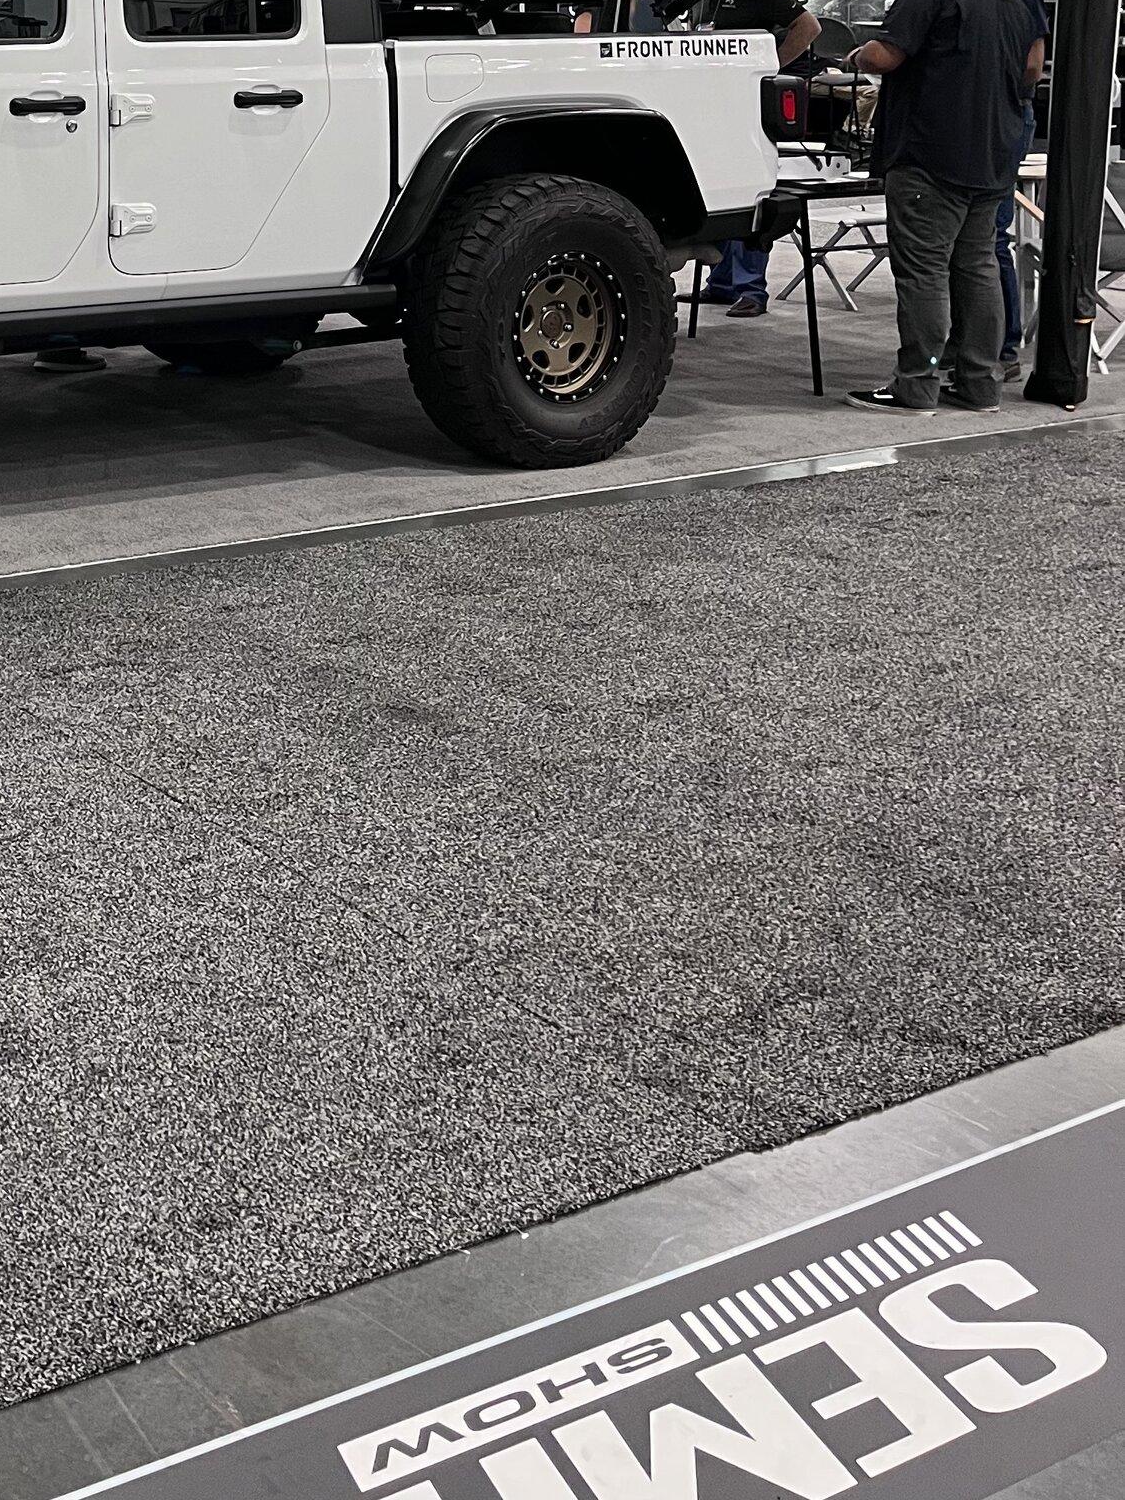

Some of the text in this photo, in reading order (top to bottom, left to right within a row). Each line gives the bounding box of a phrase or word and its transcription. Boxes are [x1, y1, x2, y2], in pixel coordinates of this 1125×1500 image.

[616, 38, 749, 58] FRONT RUNNER
[361, 1258, 1108, 1500] SEM
[371, 1338, 672, 1475] SHOW
